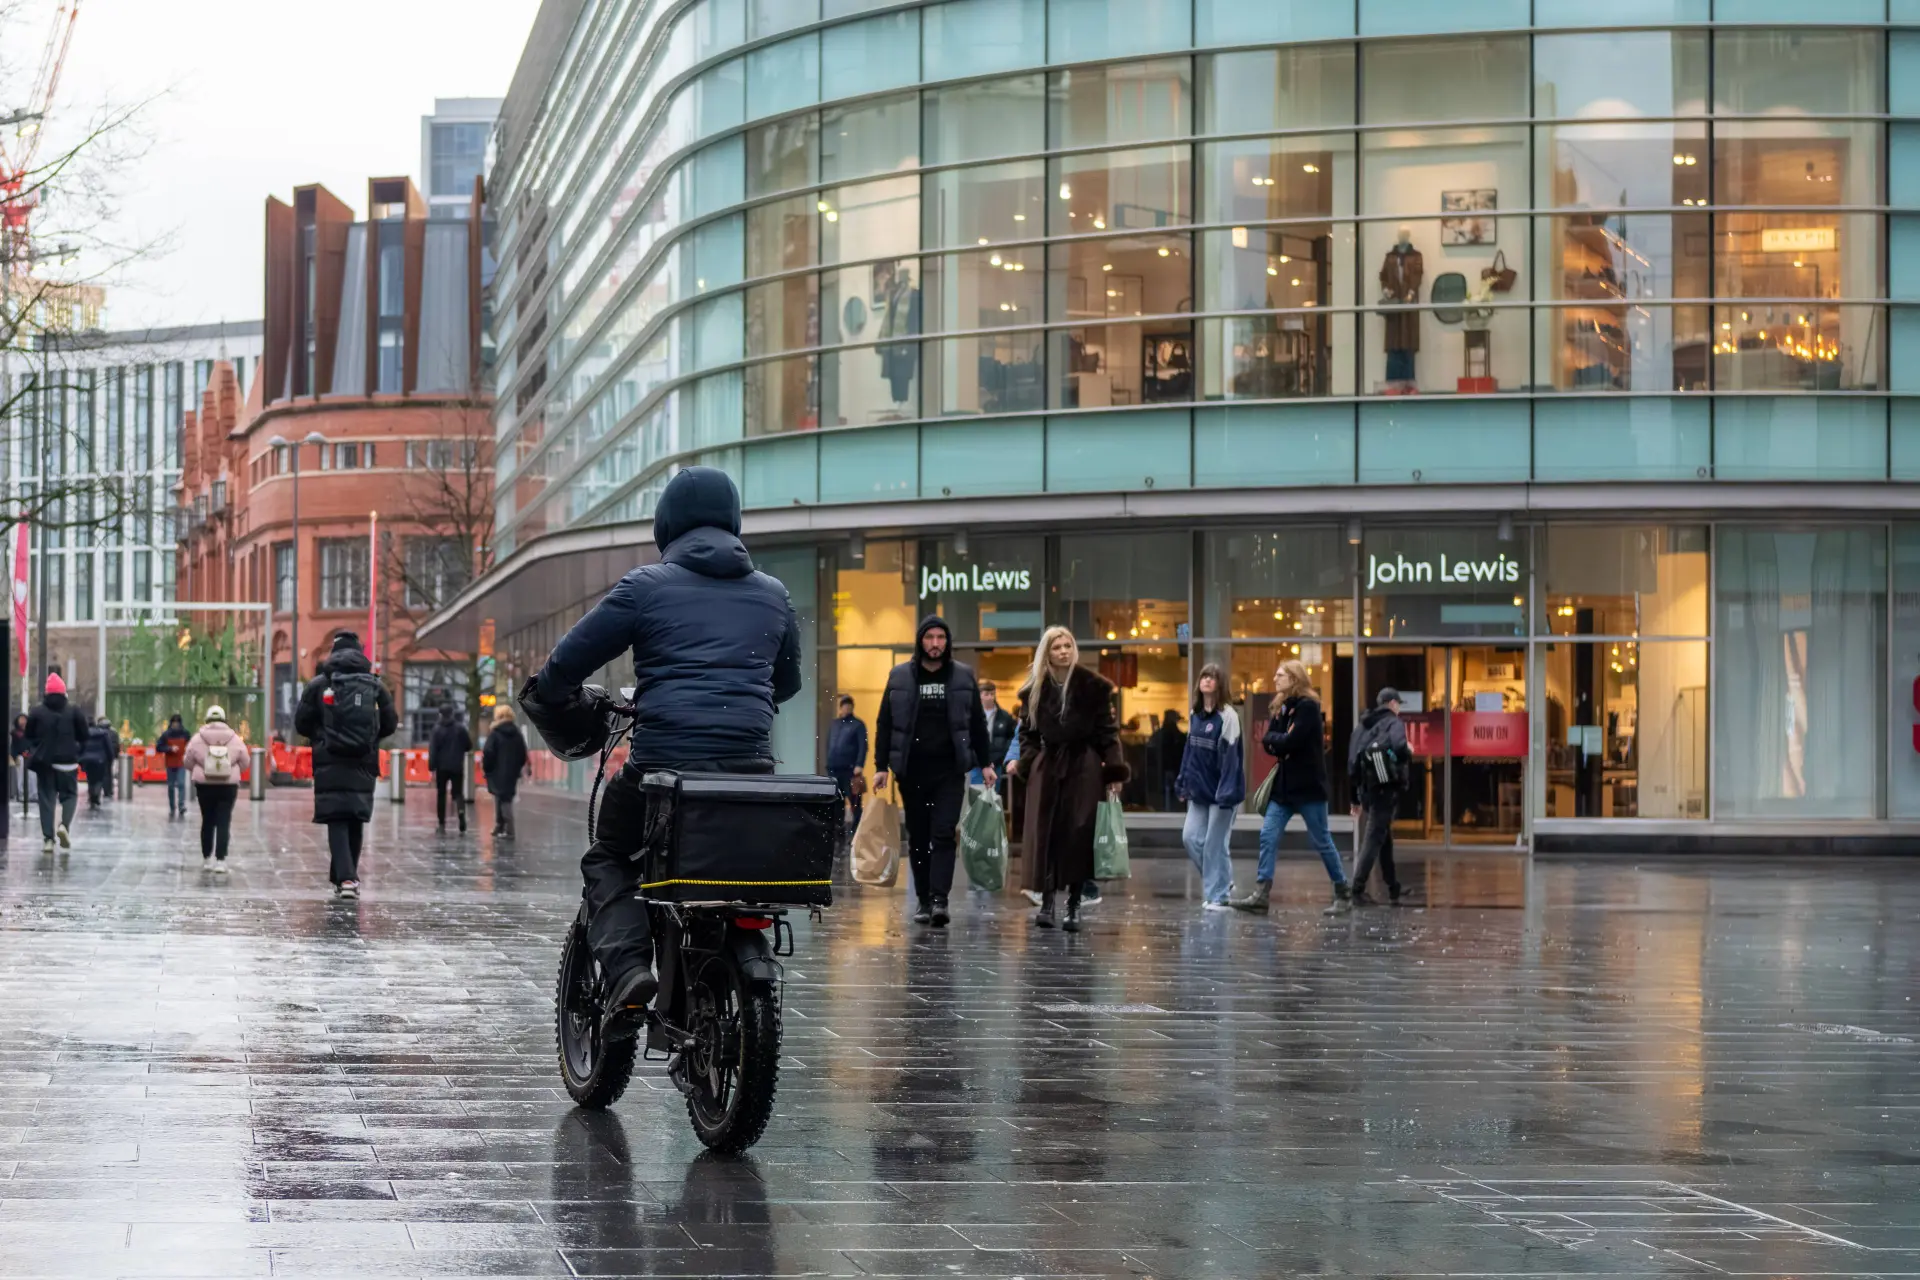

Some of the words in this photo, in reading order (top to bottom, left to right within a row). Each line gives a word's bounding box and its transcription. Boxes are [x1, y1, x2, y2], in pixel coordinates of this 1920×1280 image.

[919, 565, 968, 600] John
[972, 563, 1030, 591] Lewis
[1367, 554, 1432, 590] John
[1441, 553, 1519, 582] Lewis
[1472, 725, 1494, 741] NOW
[1496, 725, 1509, 741] ON
